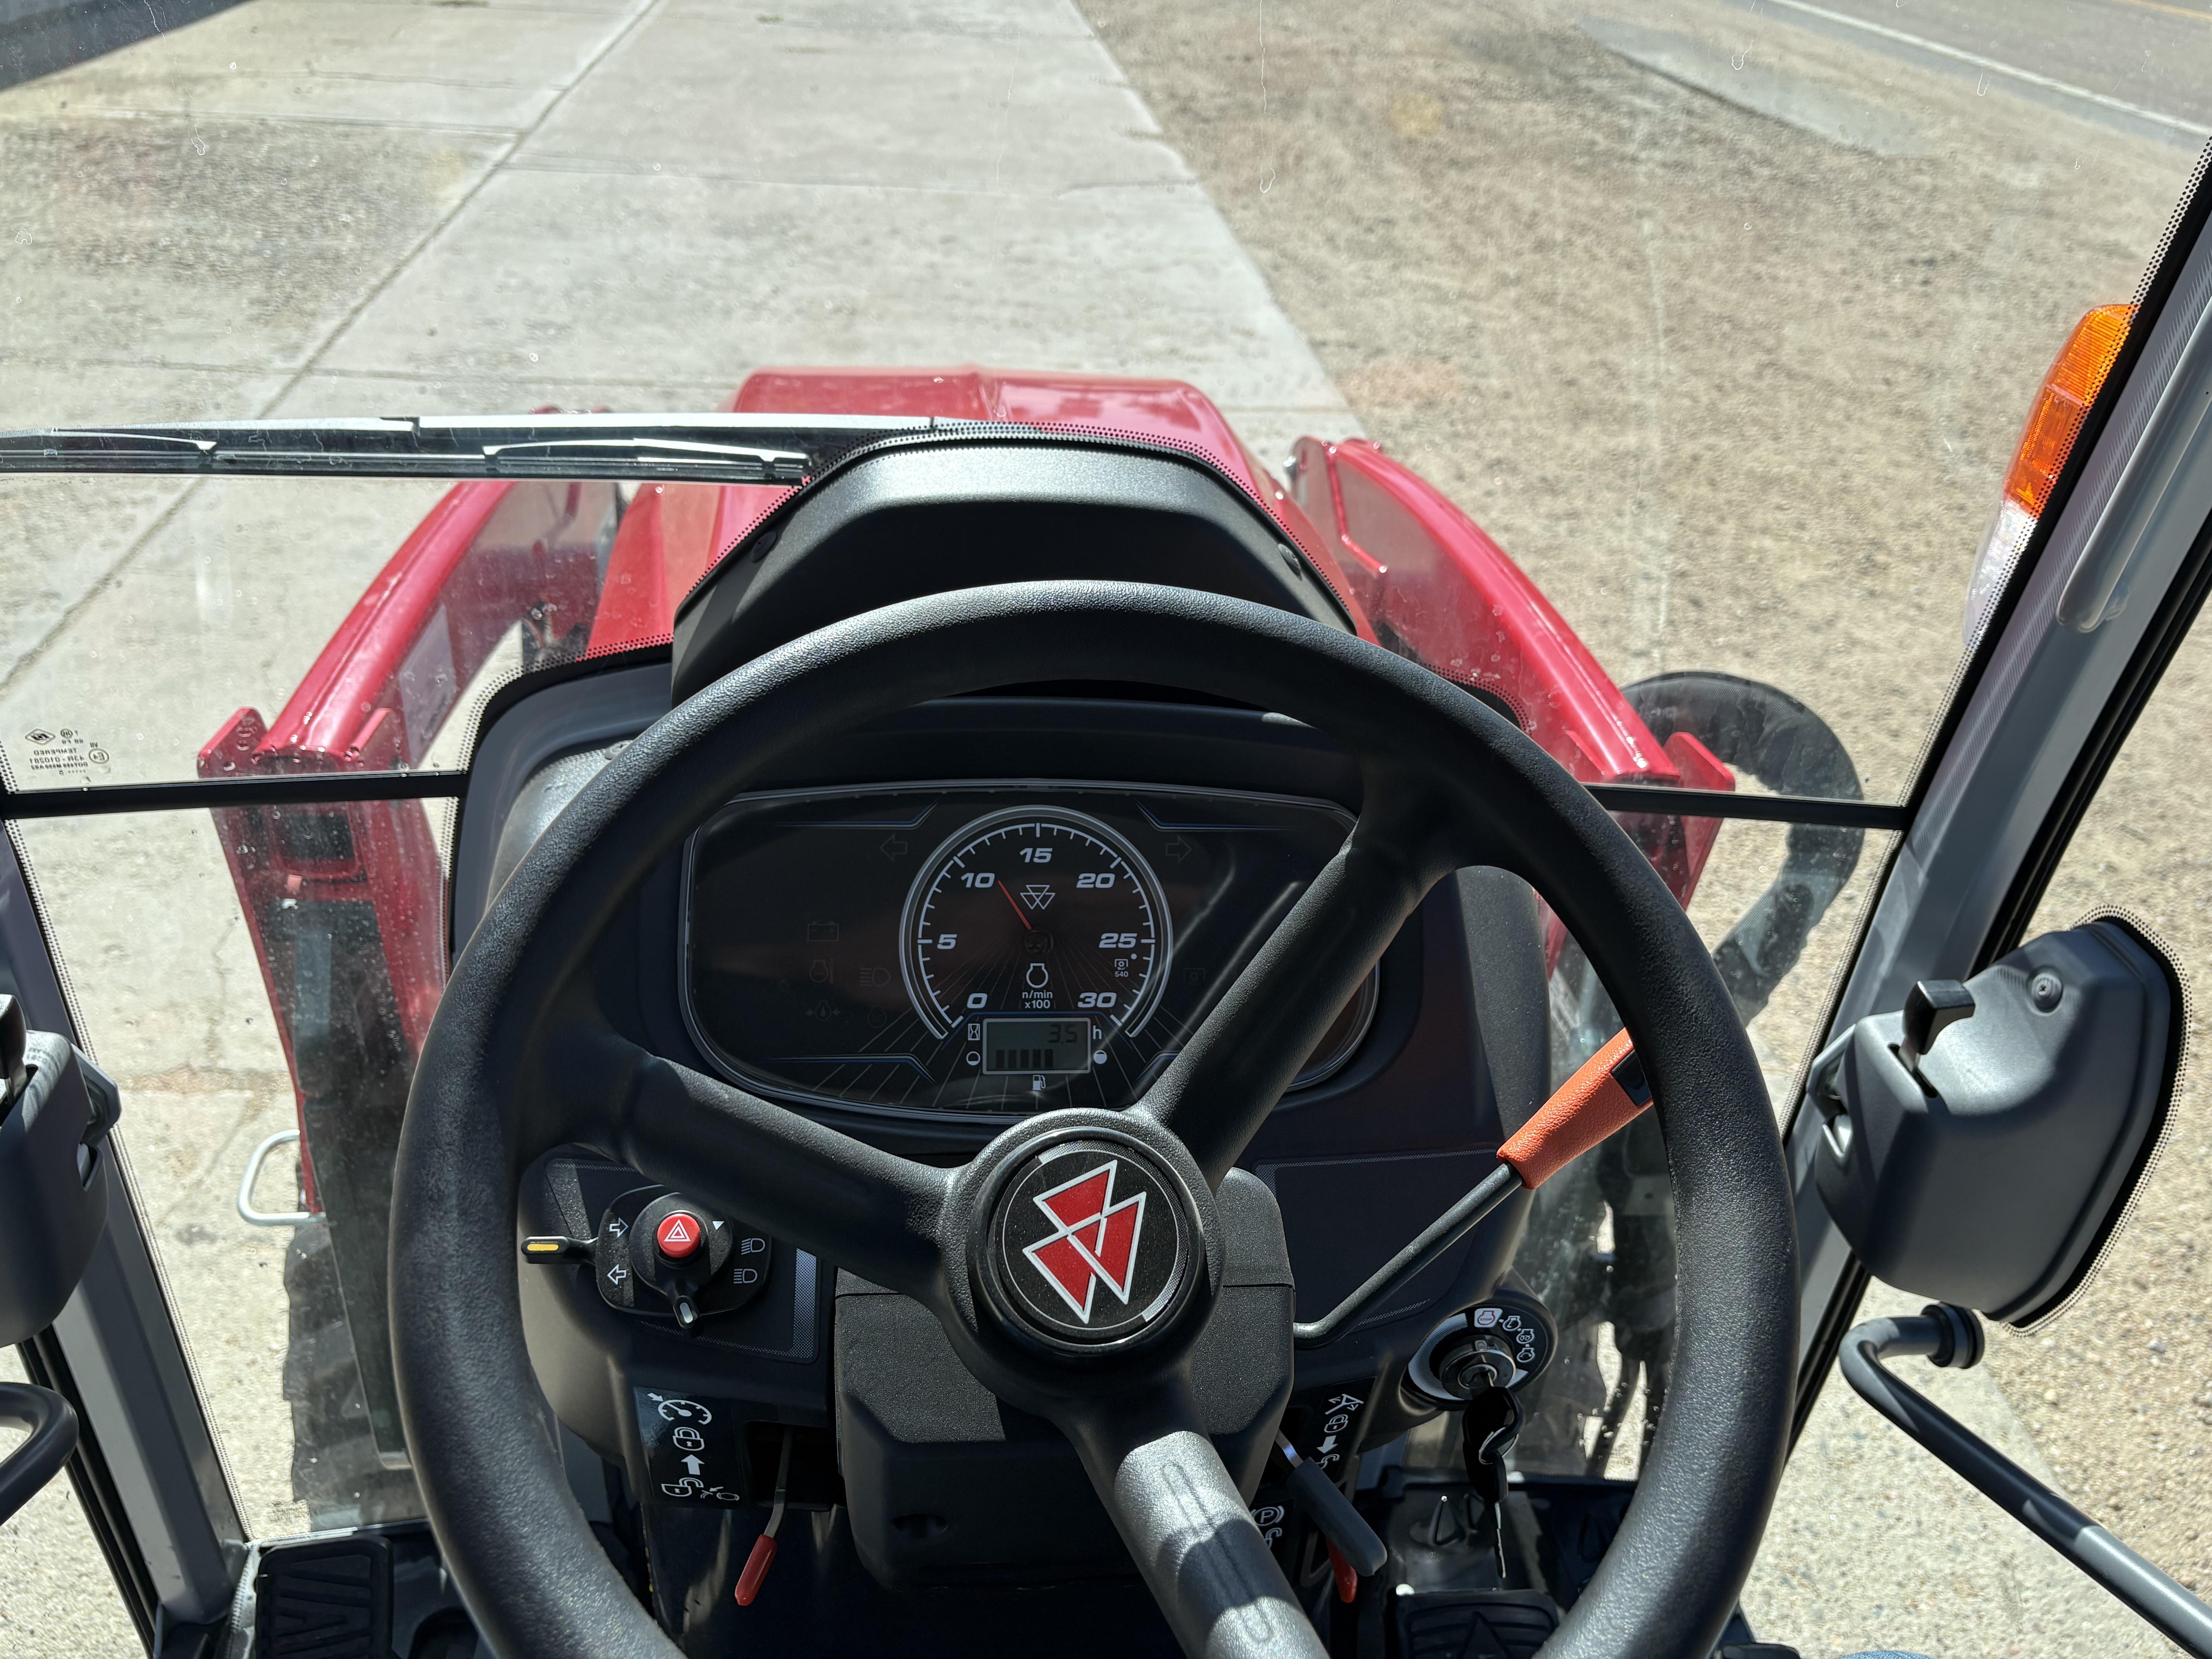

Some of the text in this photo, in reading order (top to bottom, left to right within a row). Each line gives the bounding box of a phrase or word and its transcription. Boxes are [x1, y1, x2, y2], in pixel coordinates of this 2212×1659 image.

[1020, 848, 1053, 863] 15
[961, 872, 995, 888] 10
[1076, 873, 1115, 889] 20
[937, 934, 957, 950] 5
[1099, 933, 1137, 948] 25
[967, 993, 988, 1009] 0
[1022, 990, 1053, 1000] n/min
[1077, 992, 1117, 1008] 30
[1025, 999, 1051, 1009] x100
[1048, 1023, 1078, 1044] 3.5
[1093, 1025, 1103, 1040] h
